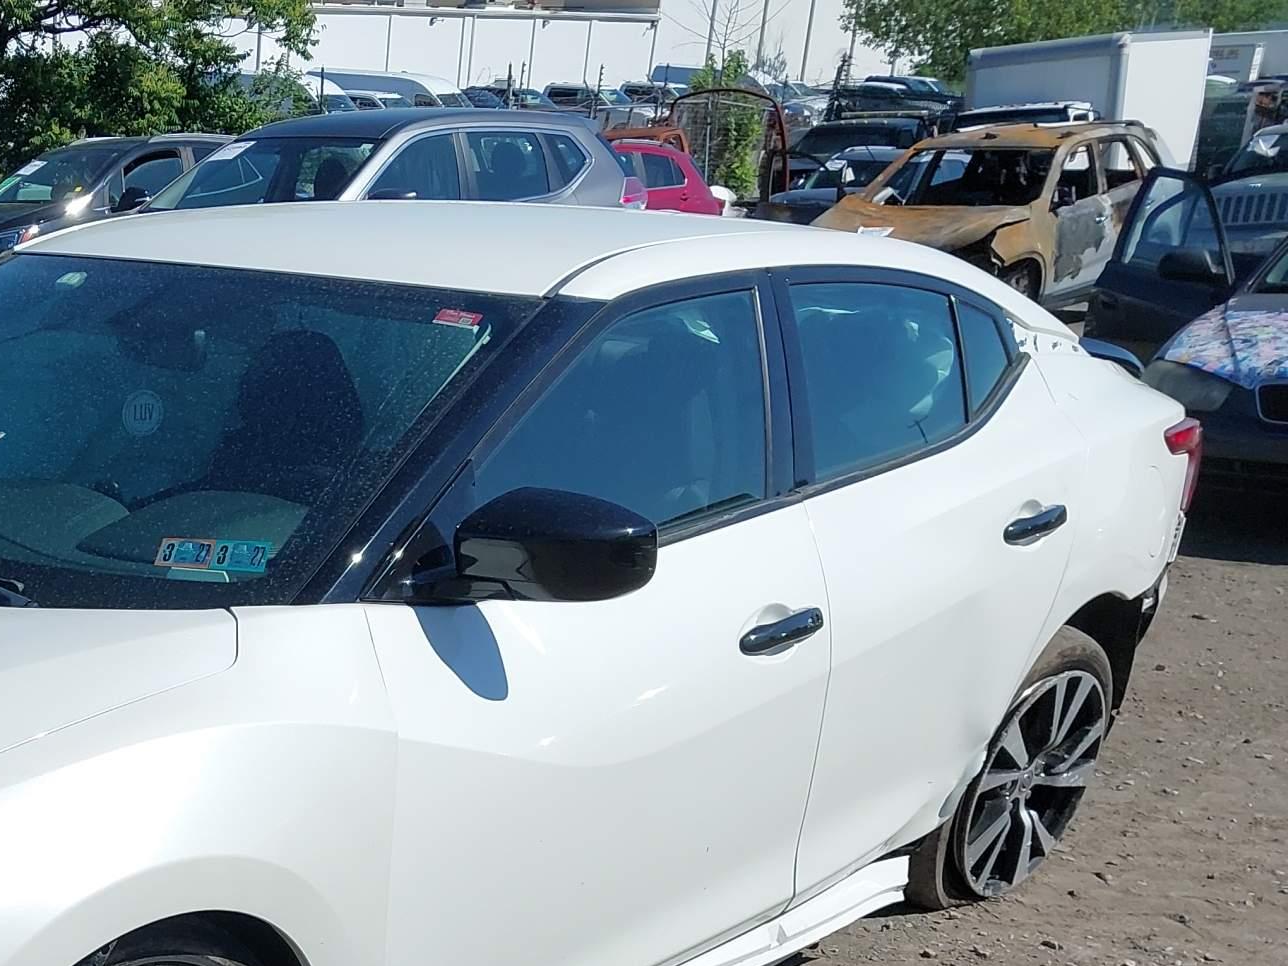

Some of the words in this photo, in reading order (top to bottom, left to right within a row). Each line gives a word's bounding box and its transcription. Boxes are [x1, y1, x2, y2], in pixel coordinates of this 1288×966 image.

[162, 543, 175, 562] 3
[195, 543, 212, 562] 27
[216, 545, 229, 565] 3
[250, 546, 267, 567] 27
